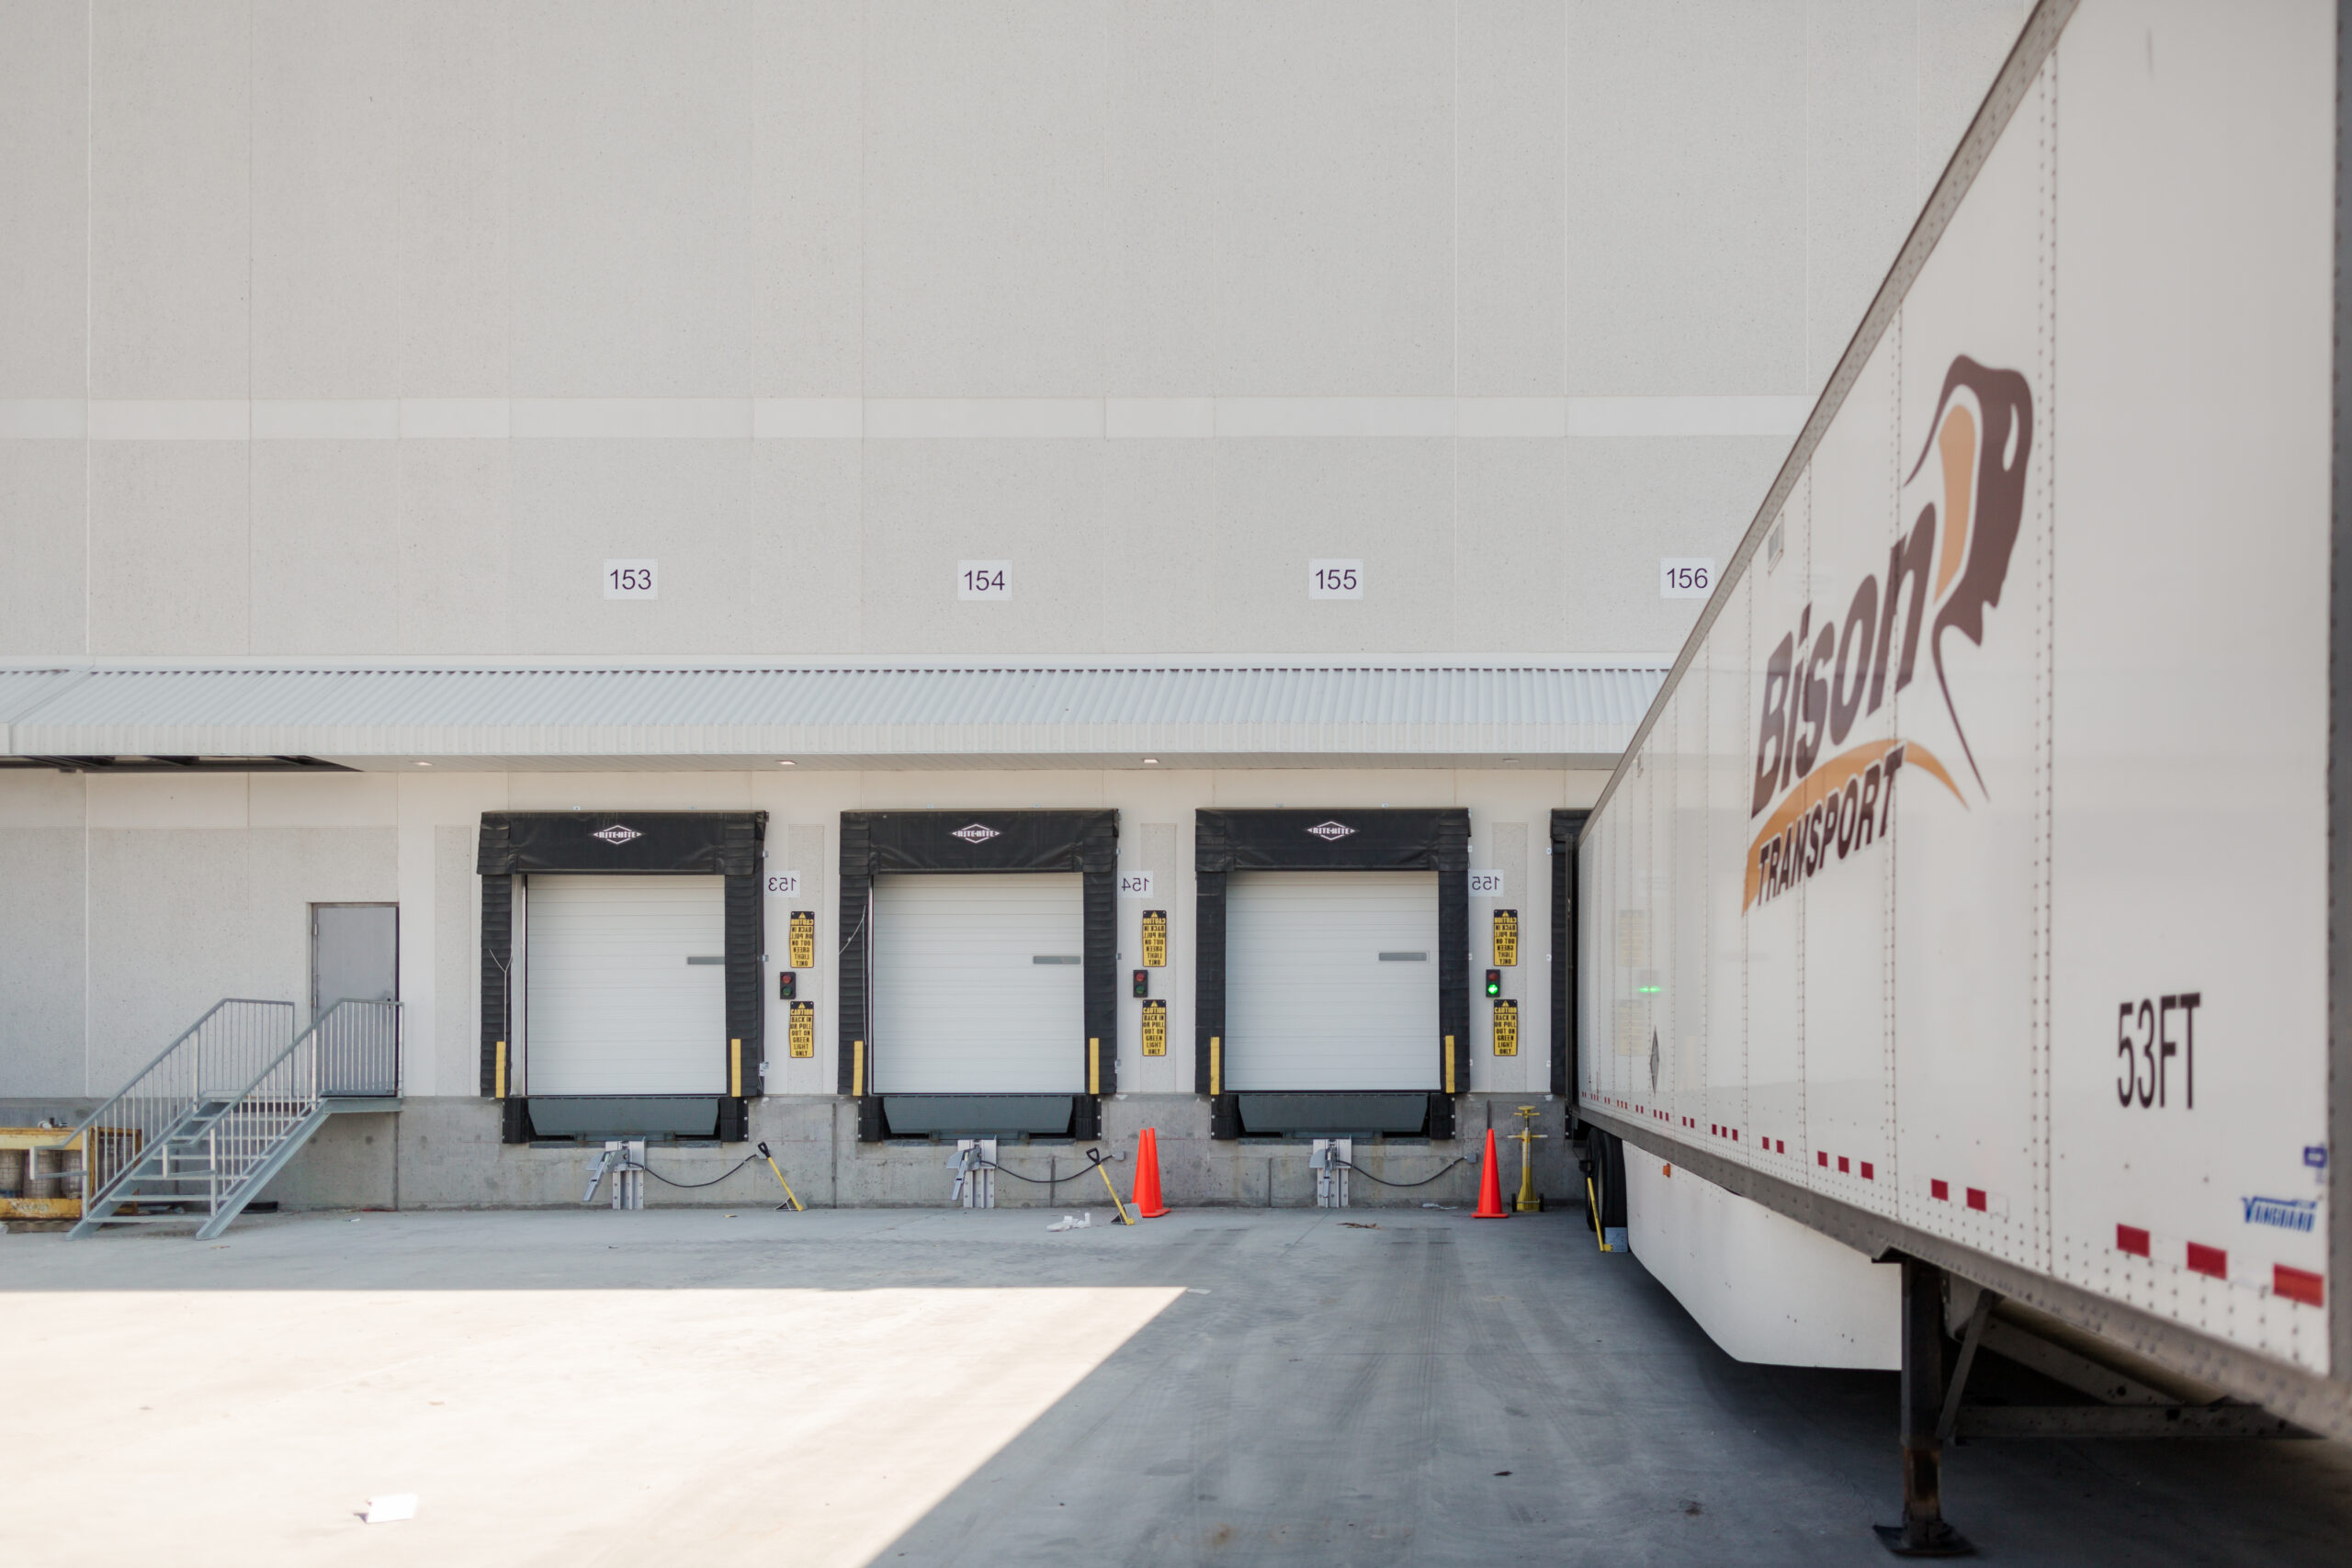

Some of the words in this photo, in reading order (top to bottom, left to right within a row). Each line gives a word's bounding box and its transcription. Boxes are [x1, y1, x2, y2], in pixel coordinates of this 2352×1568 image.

[610, 569, 651, 590] 153
[964, 570, 1005, 591] 154
[1315, 569, 1357, 590] 155
[1667, 568, 1708, 589] 156
[1751, 502, 1936, 819] Bison
[1758, 746, 1905, 907] TRANSPORT
[2117, 992, 2201, 1109] 53FT
[2242, 1196, 2316, 1232] VANGUARD
